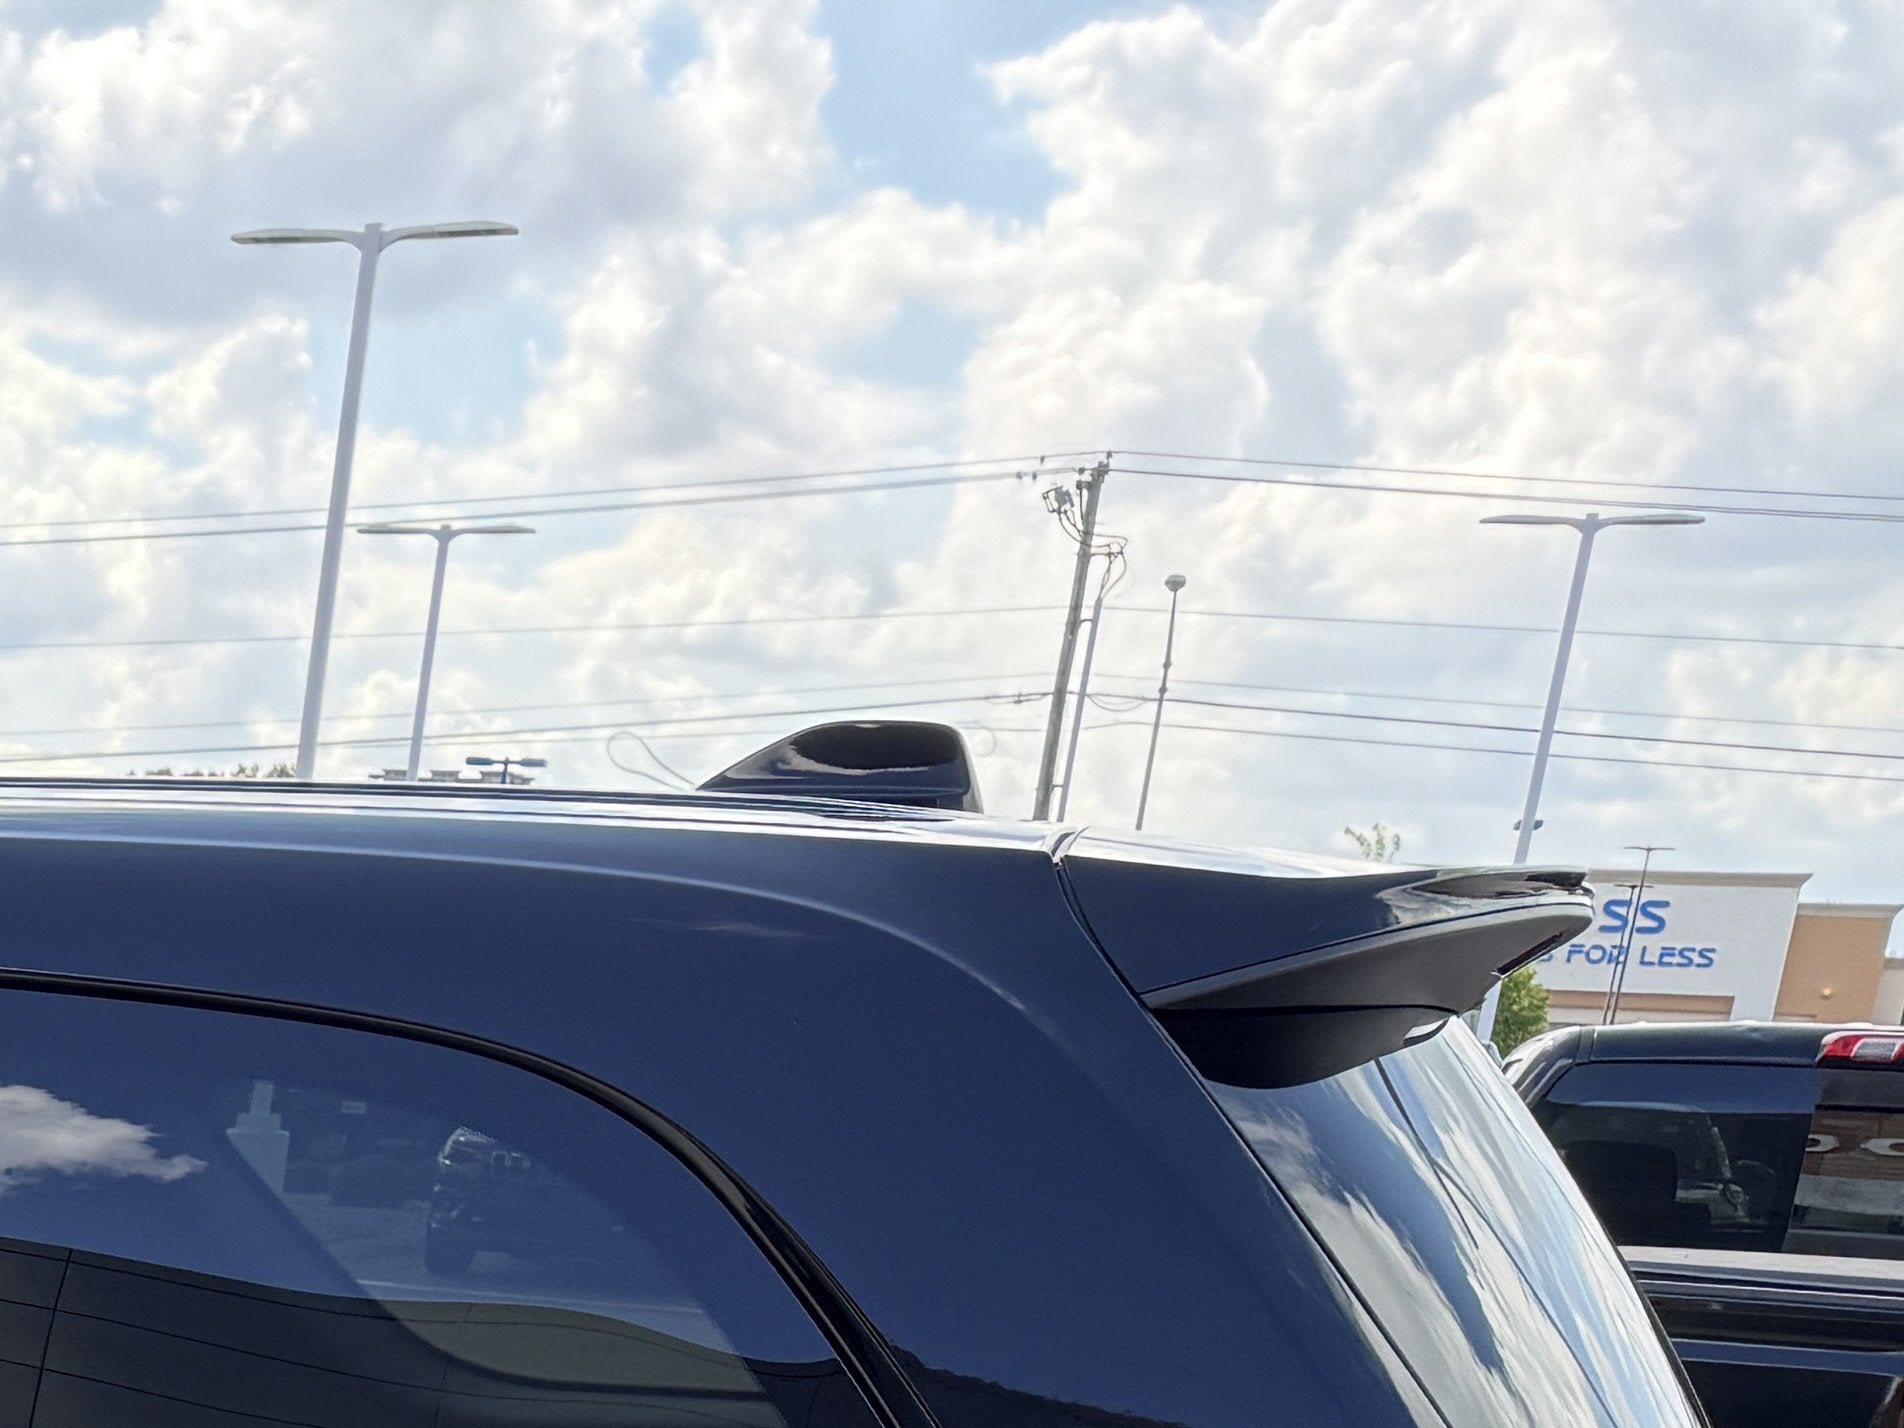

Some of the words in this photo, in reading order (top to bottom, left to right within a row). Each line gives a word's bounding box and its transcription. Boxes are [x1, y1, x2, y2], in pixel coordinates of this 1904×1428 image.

[1598, 899, 1671, 935] SS
[1566, 944, 1627, 966] FOR
[1639, 945, 1717, 968] LESS
